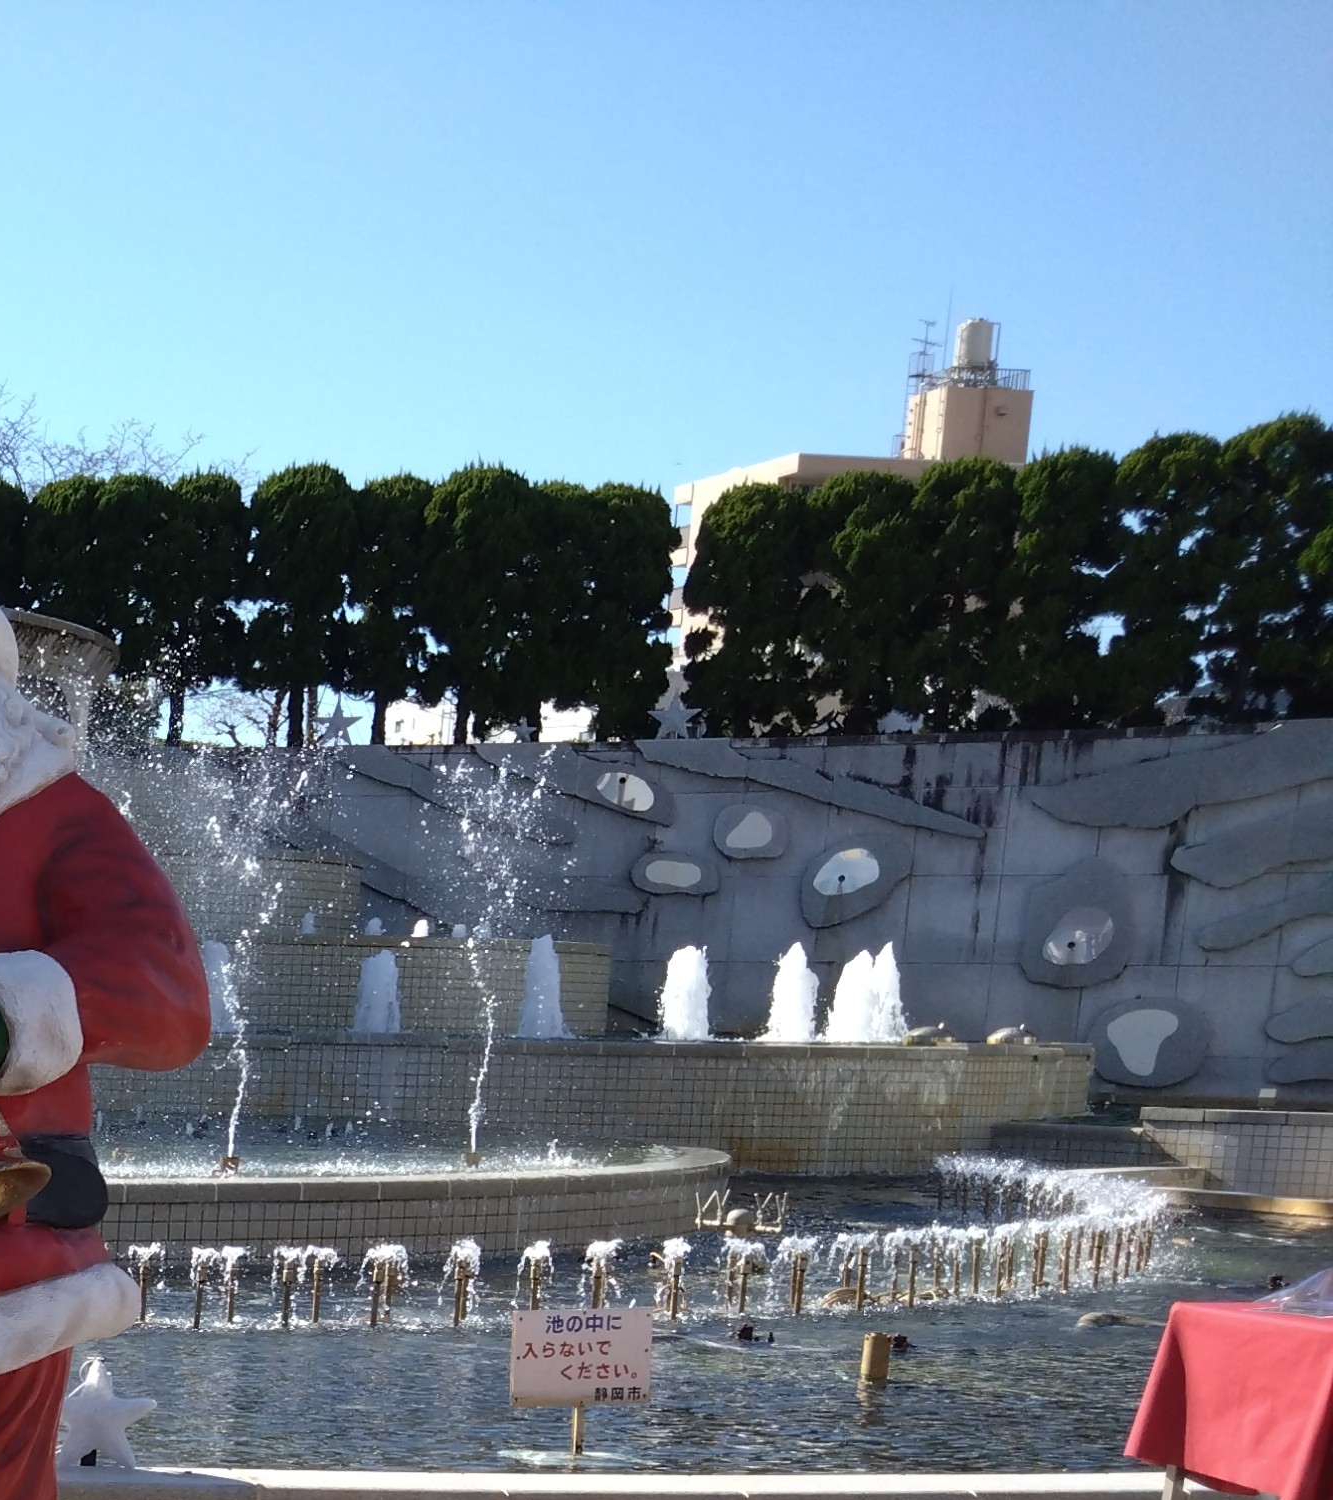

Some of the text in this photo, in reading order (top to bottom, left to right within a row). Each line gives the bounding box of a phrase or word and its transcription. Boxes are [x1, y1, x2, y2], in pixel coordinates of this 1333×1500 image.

[545, 1314, 622, 1334] 池の中に
[522, 1340, 611, 1359] 入らないで
[560, 1361, 637, 1381] ください。
[594, 1386, 642, 1401] 静岡市
